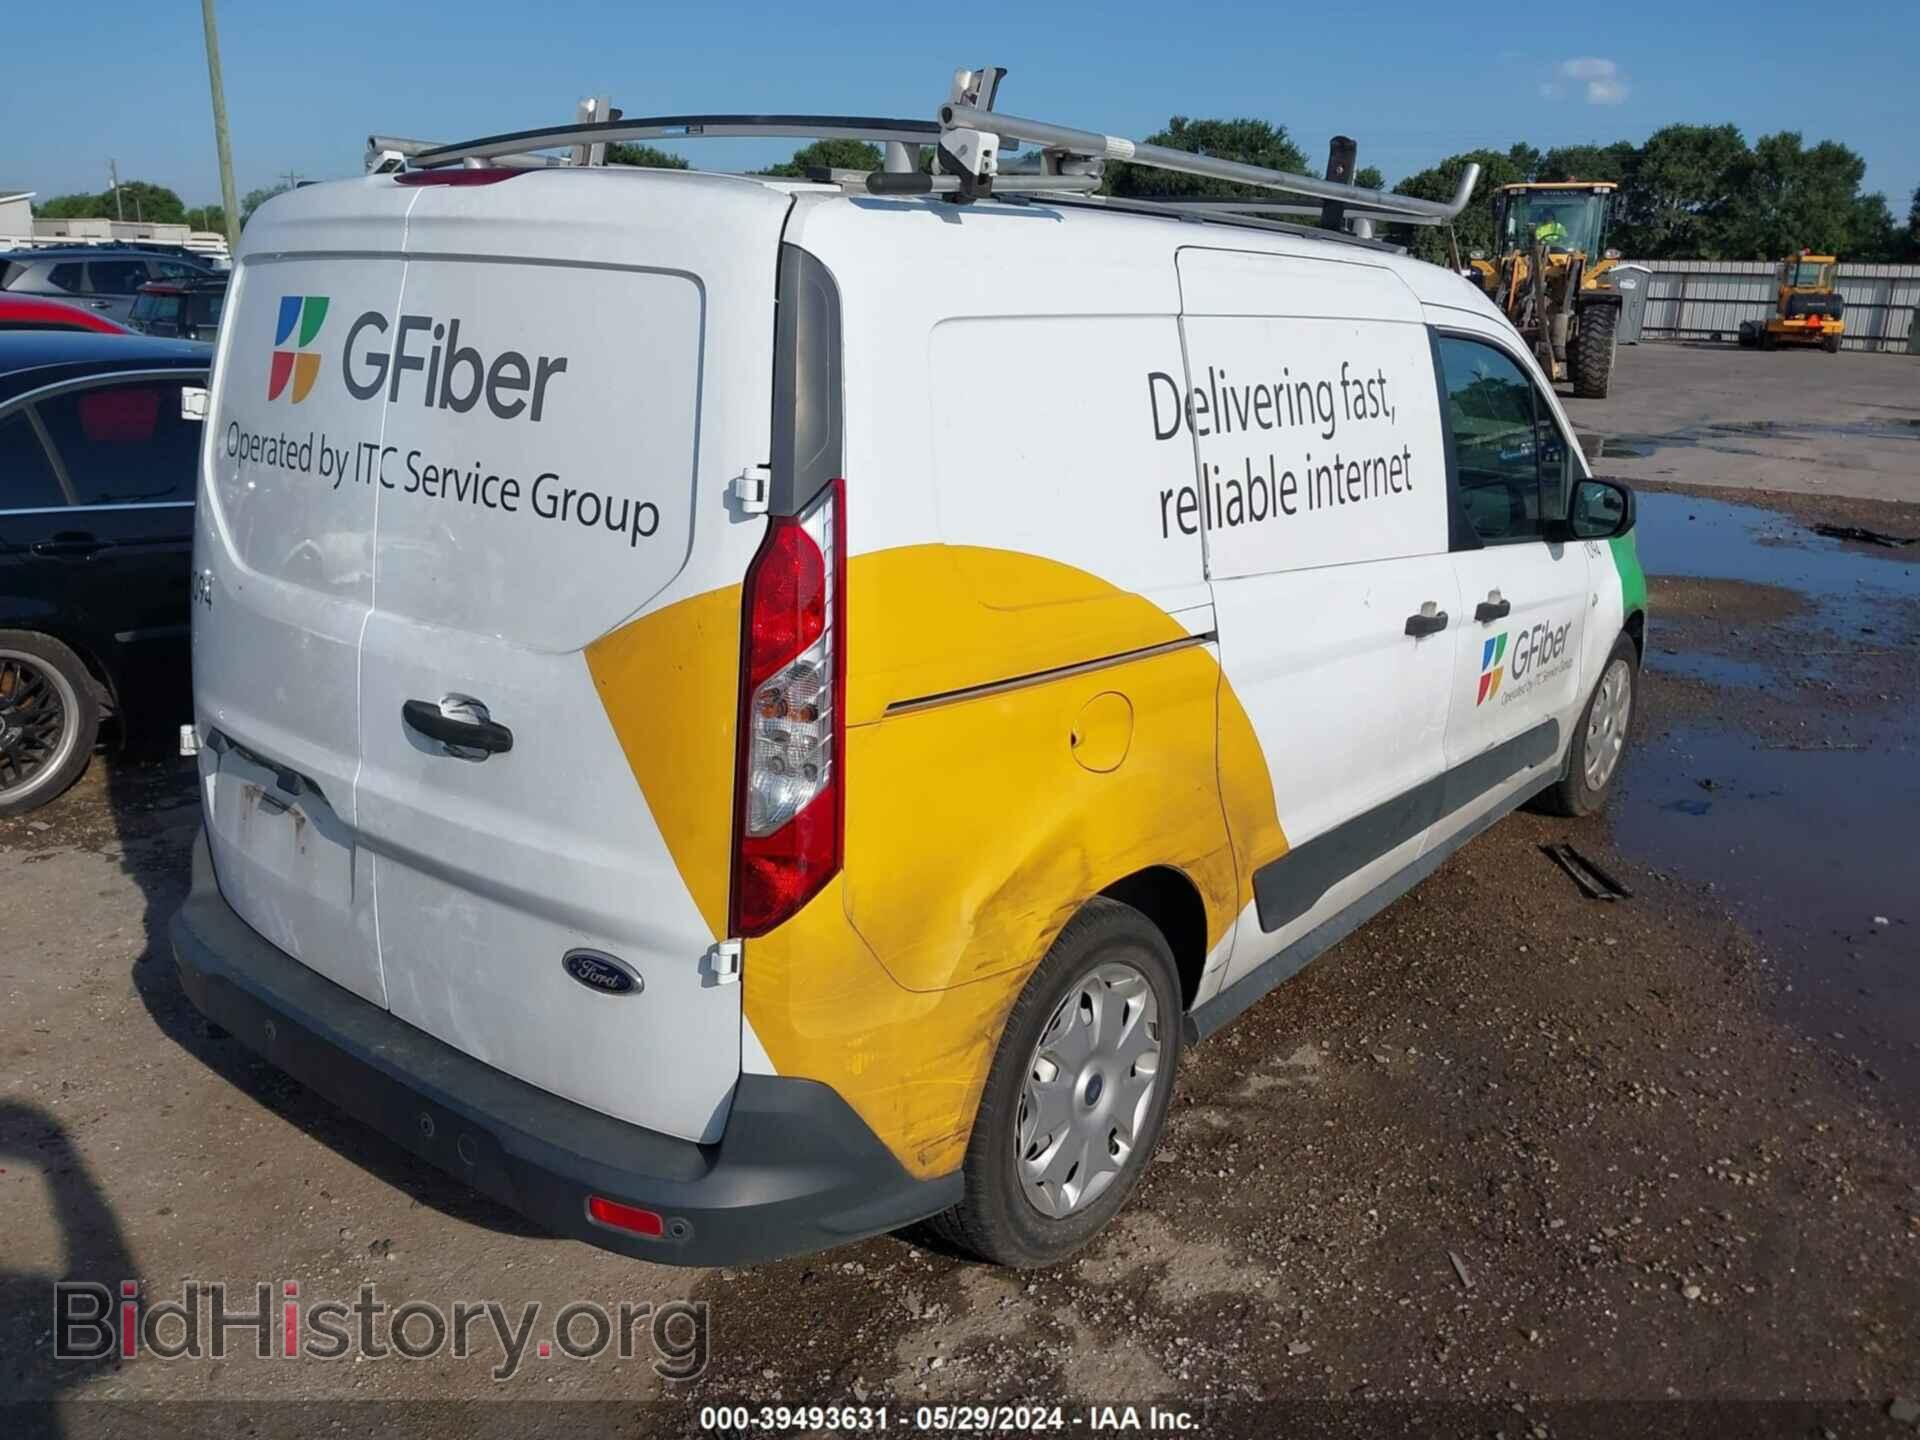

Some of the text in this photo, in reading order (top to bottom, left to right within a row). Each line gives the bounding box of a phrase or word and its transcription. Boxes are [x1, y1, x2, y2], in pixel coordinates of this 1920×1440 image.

[343, 311, 568, 422] GFiber
[1147, 361, 1396, 441] Delivering fast,
[226, 421, 660, 547] Operated by ITC Service Group
[1159, 443, 1413, 539] reliable internet
[1511, 619, 1573, 681] GFiber
[578, 960, 619, 987] Ford
